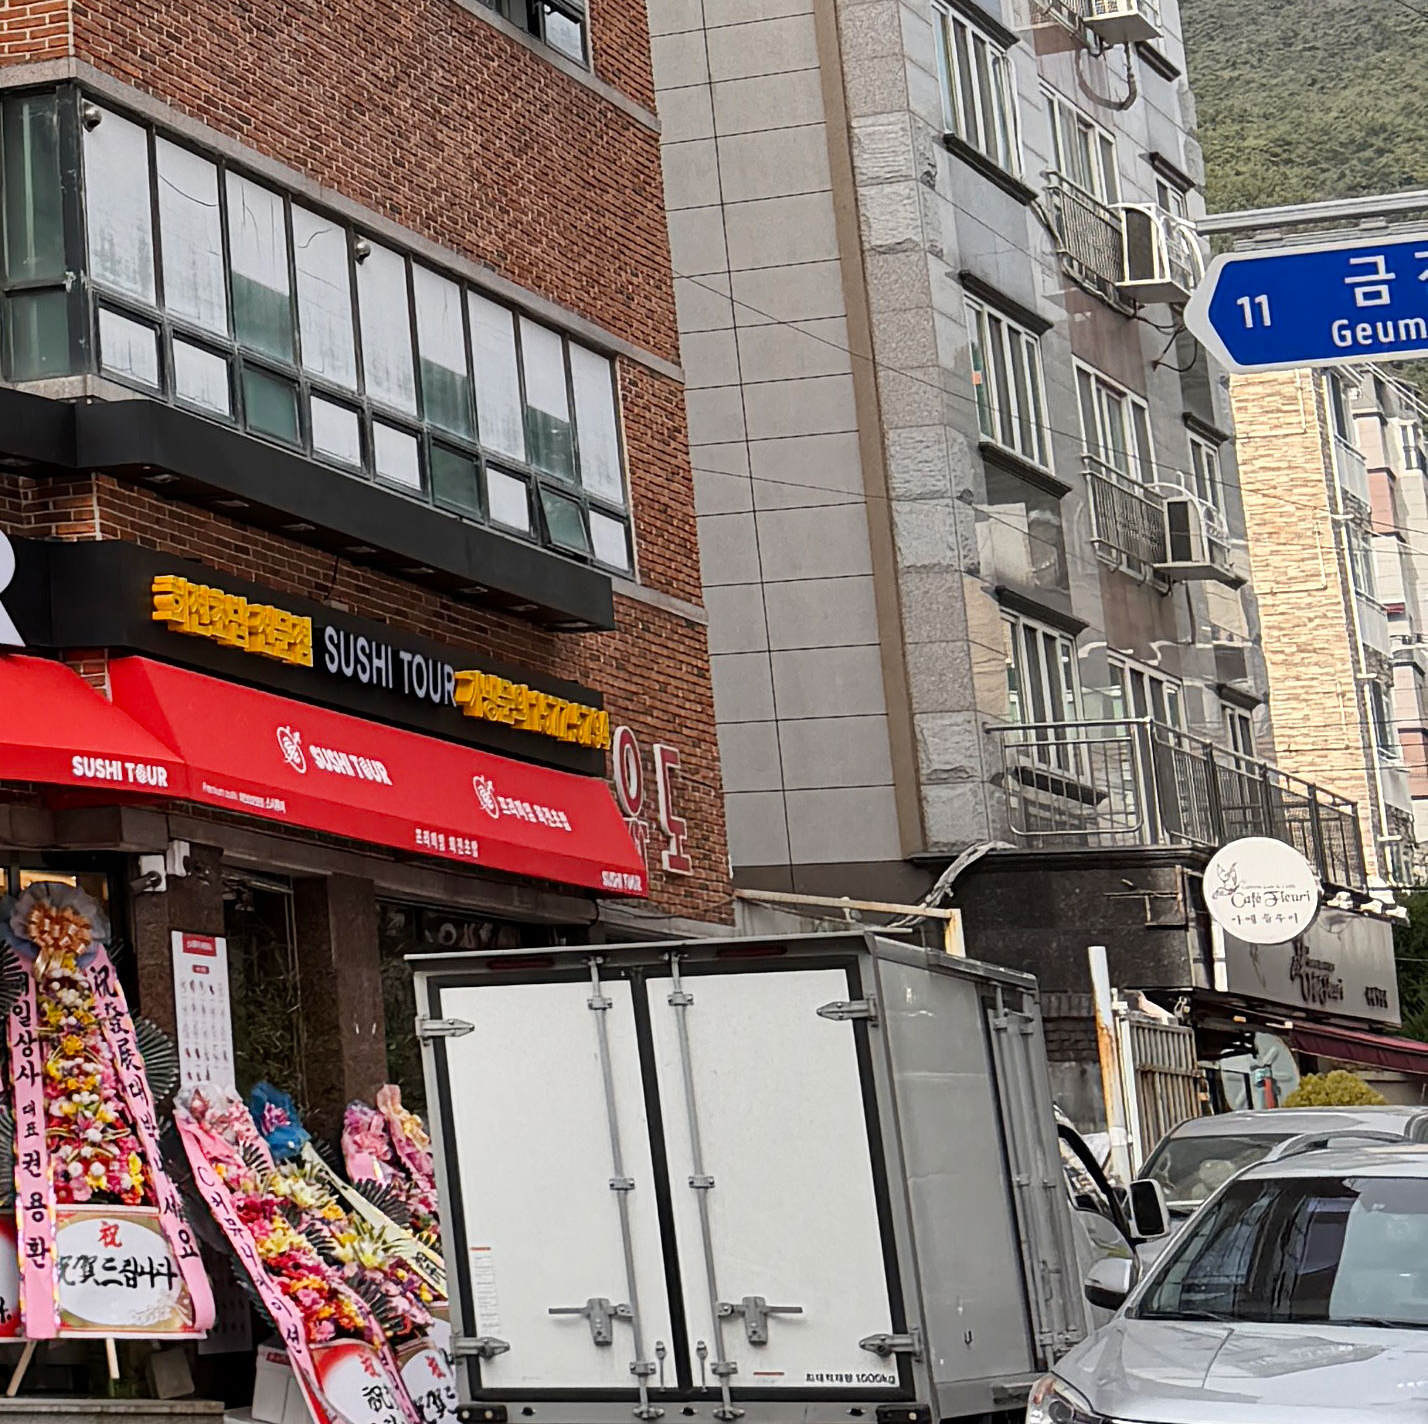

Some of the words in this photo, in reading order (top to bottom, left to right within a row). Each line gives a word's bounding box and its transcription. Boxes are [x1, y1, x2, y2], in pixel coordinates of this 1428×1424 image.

[1344, 251, 1428, 308] 금
[1236, 294, 1272, 329] 11
[325, 625, 394, 689] SUSHI
[399, 651, 457, 707] TOUR
[72, 754, 124, 782] SUSHI
[125, 760, 169, 789] TOUR
[309, 744, 352, 777] SUSHI
[22, 1100, 38, 1139] 대표
[21, 1149, 49, 1268] 권용환
